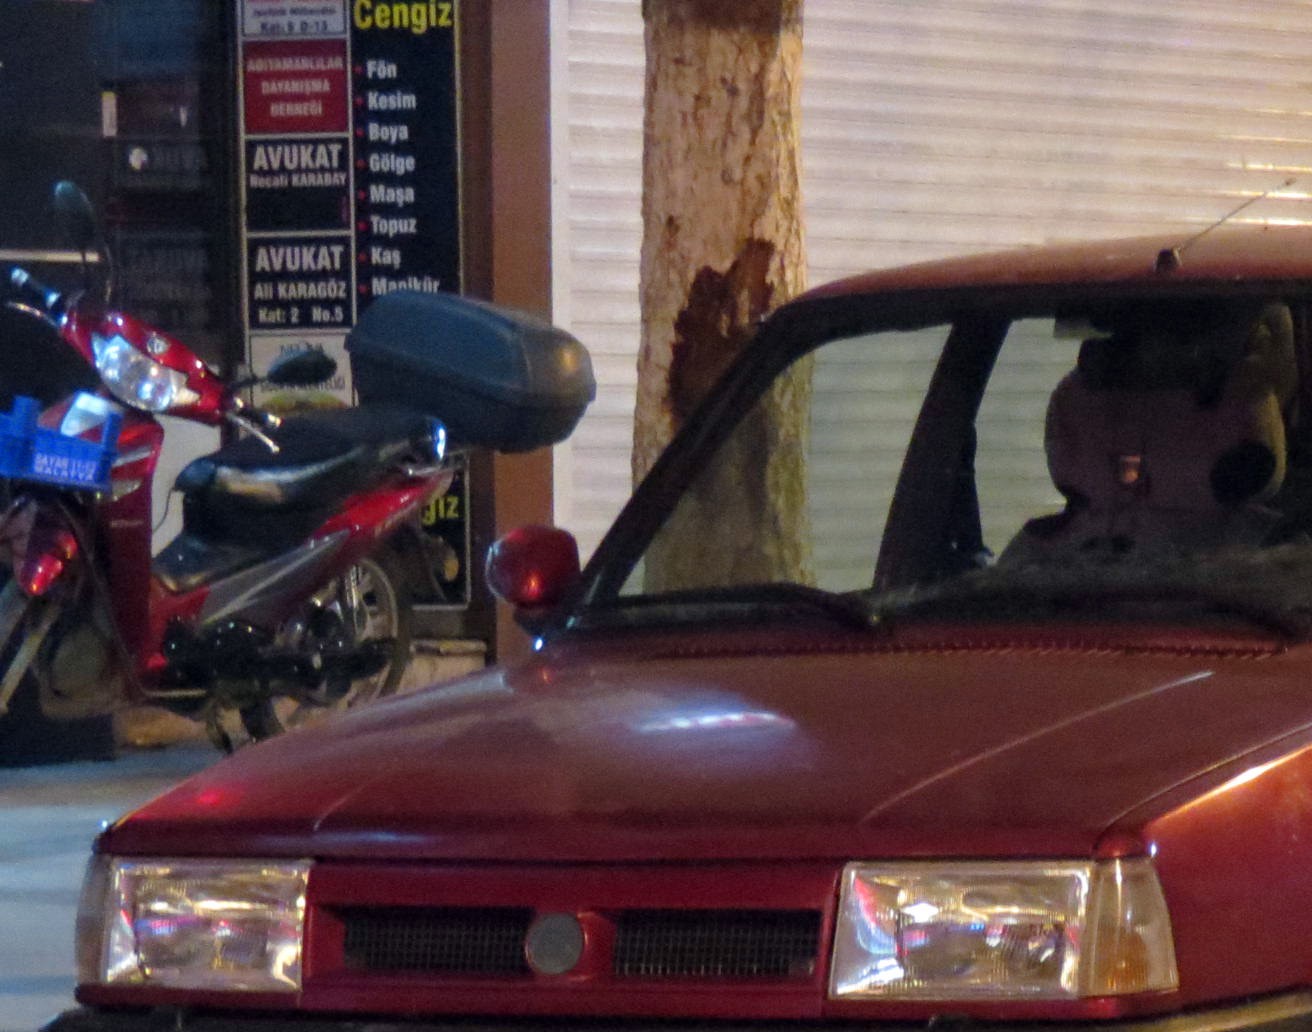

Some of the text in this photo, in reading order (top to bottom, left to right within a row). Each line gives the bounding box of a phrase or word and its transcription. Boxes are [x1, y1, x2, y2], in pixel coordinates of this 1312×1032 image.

[354, 0, 452, 34] Cengiz
[367, 60, 397, 79] Fön
[368, 90, 417, 110] Kesim
[369, 122, 409, 145] Boya
[253, 143, 342, 171] AVUKAT
[369, 153, 415, 176] Gölge
[370, 184, 415, 208] Maşa
[370, 215, 418, 238] Topuz
[255, 245, 345, 272] AVUKAT
[371, 247, 401, 270] Kaş
[254, 278, 346, 299] Ali KARAGÖZ
